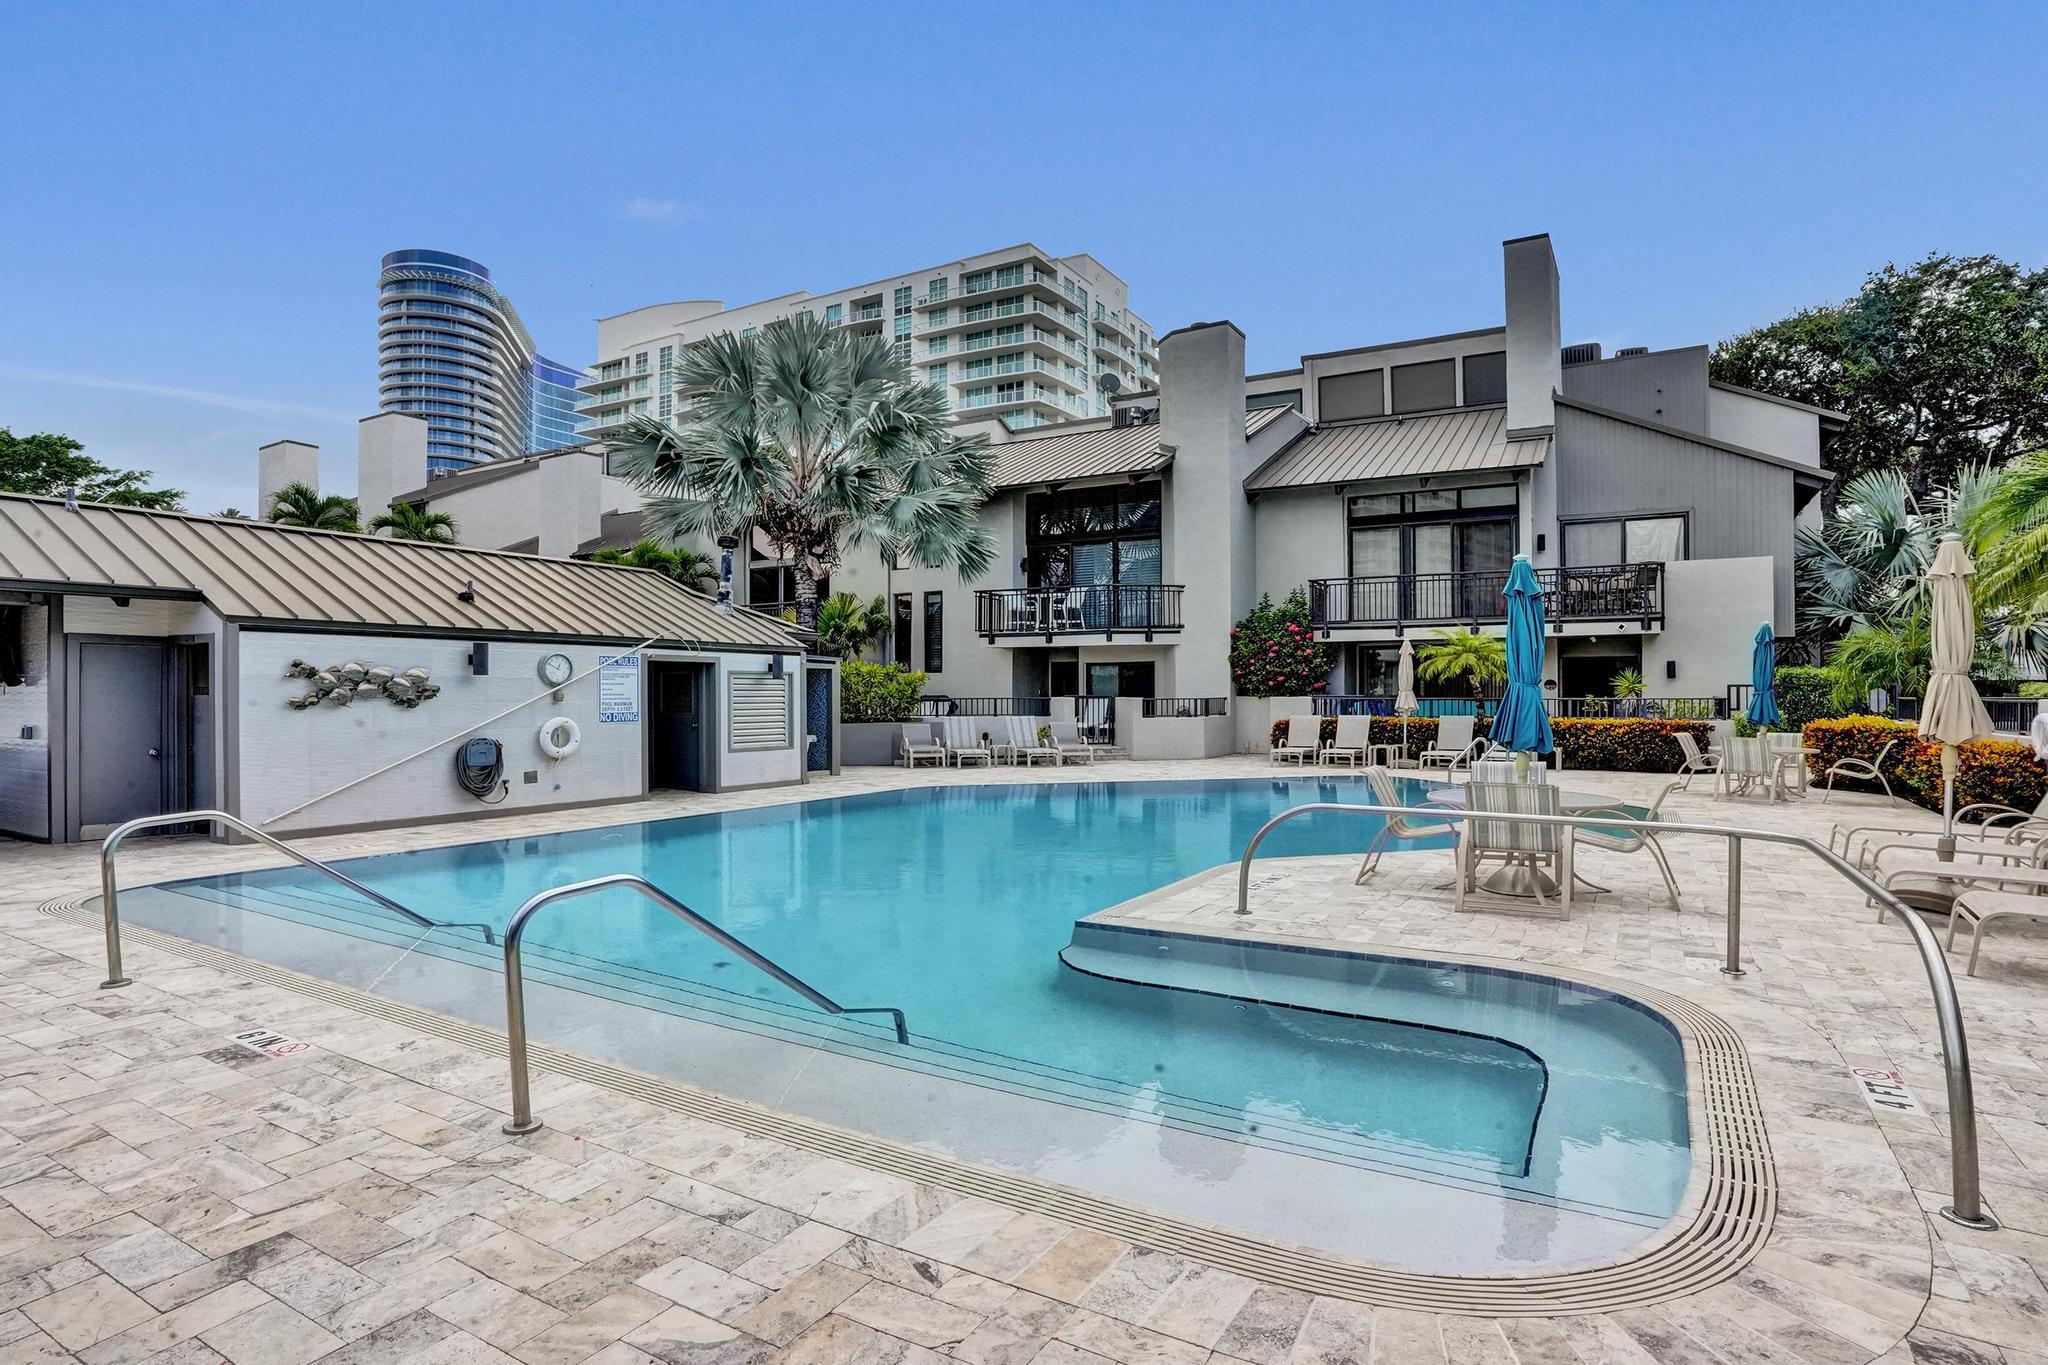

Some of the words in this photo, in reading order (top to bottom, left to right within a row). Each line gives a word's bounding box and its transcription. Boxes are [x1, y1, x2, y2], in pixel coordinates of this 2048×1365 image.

[600, 656, 618, 665] POOL
[618, 657, 638, 666] RULES
[600, 712, 611, 722] NO
[613, 712, 638, 722] DIVING
[236, 1031, 267, 1040] 6
[1873, 1099, 1914, 1109] 4
